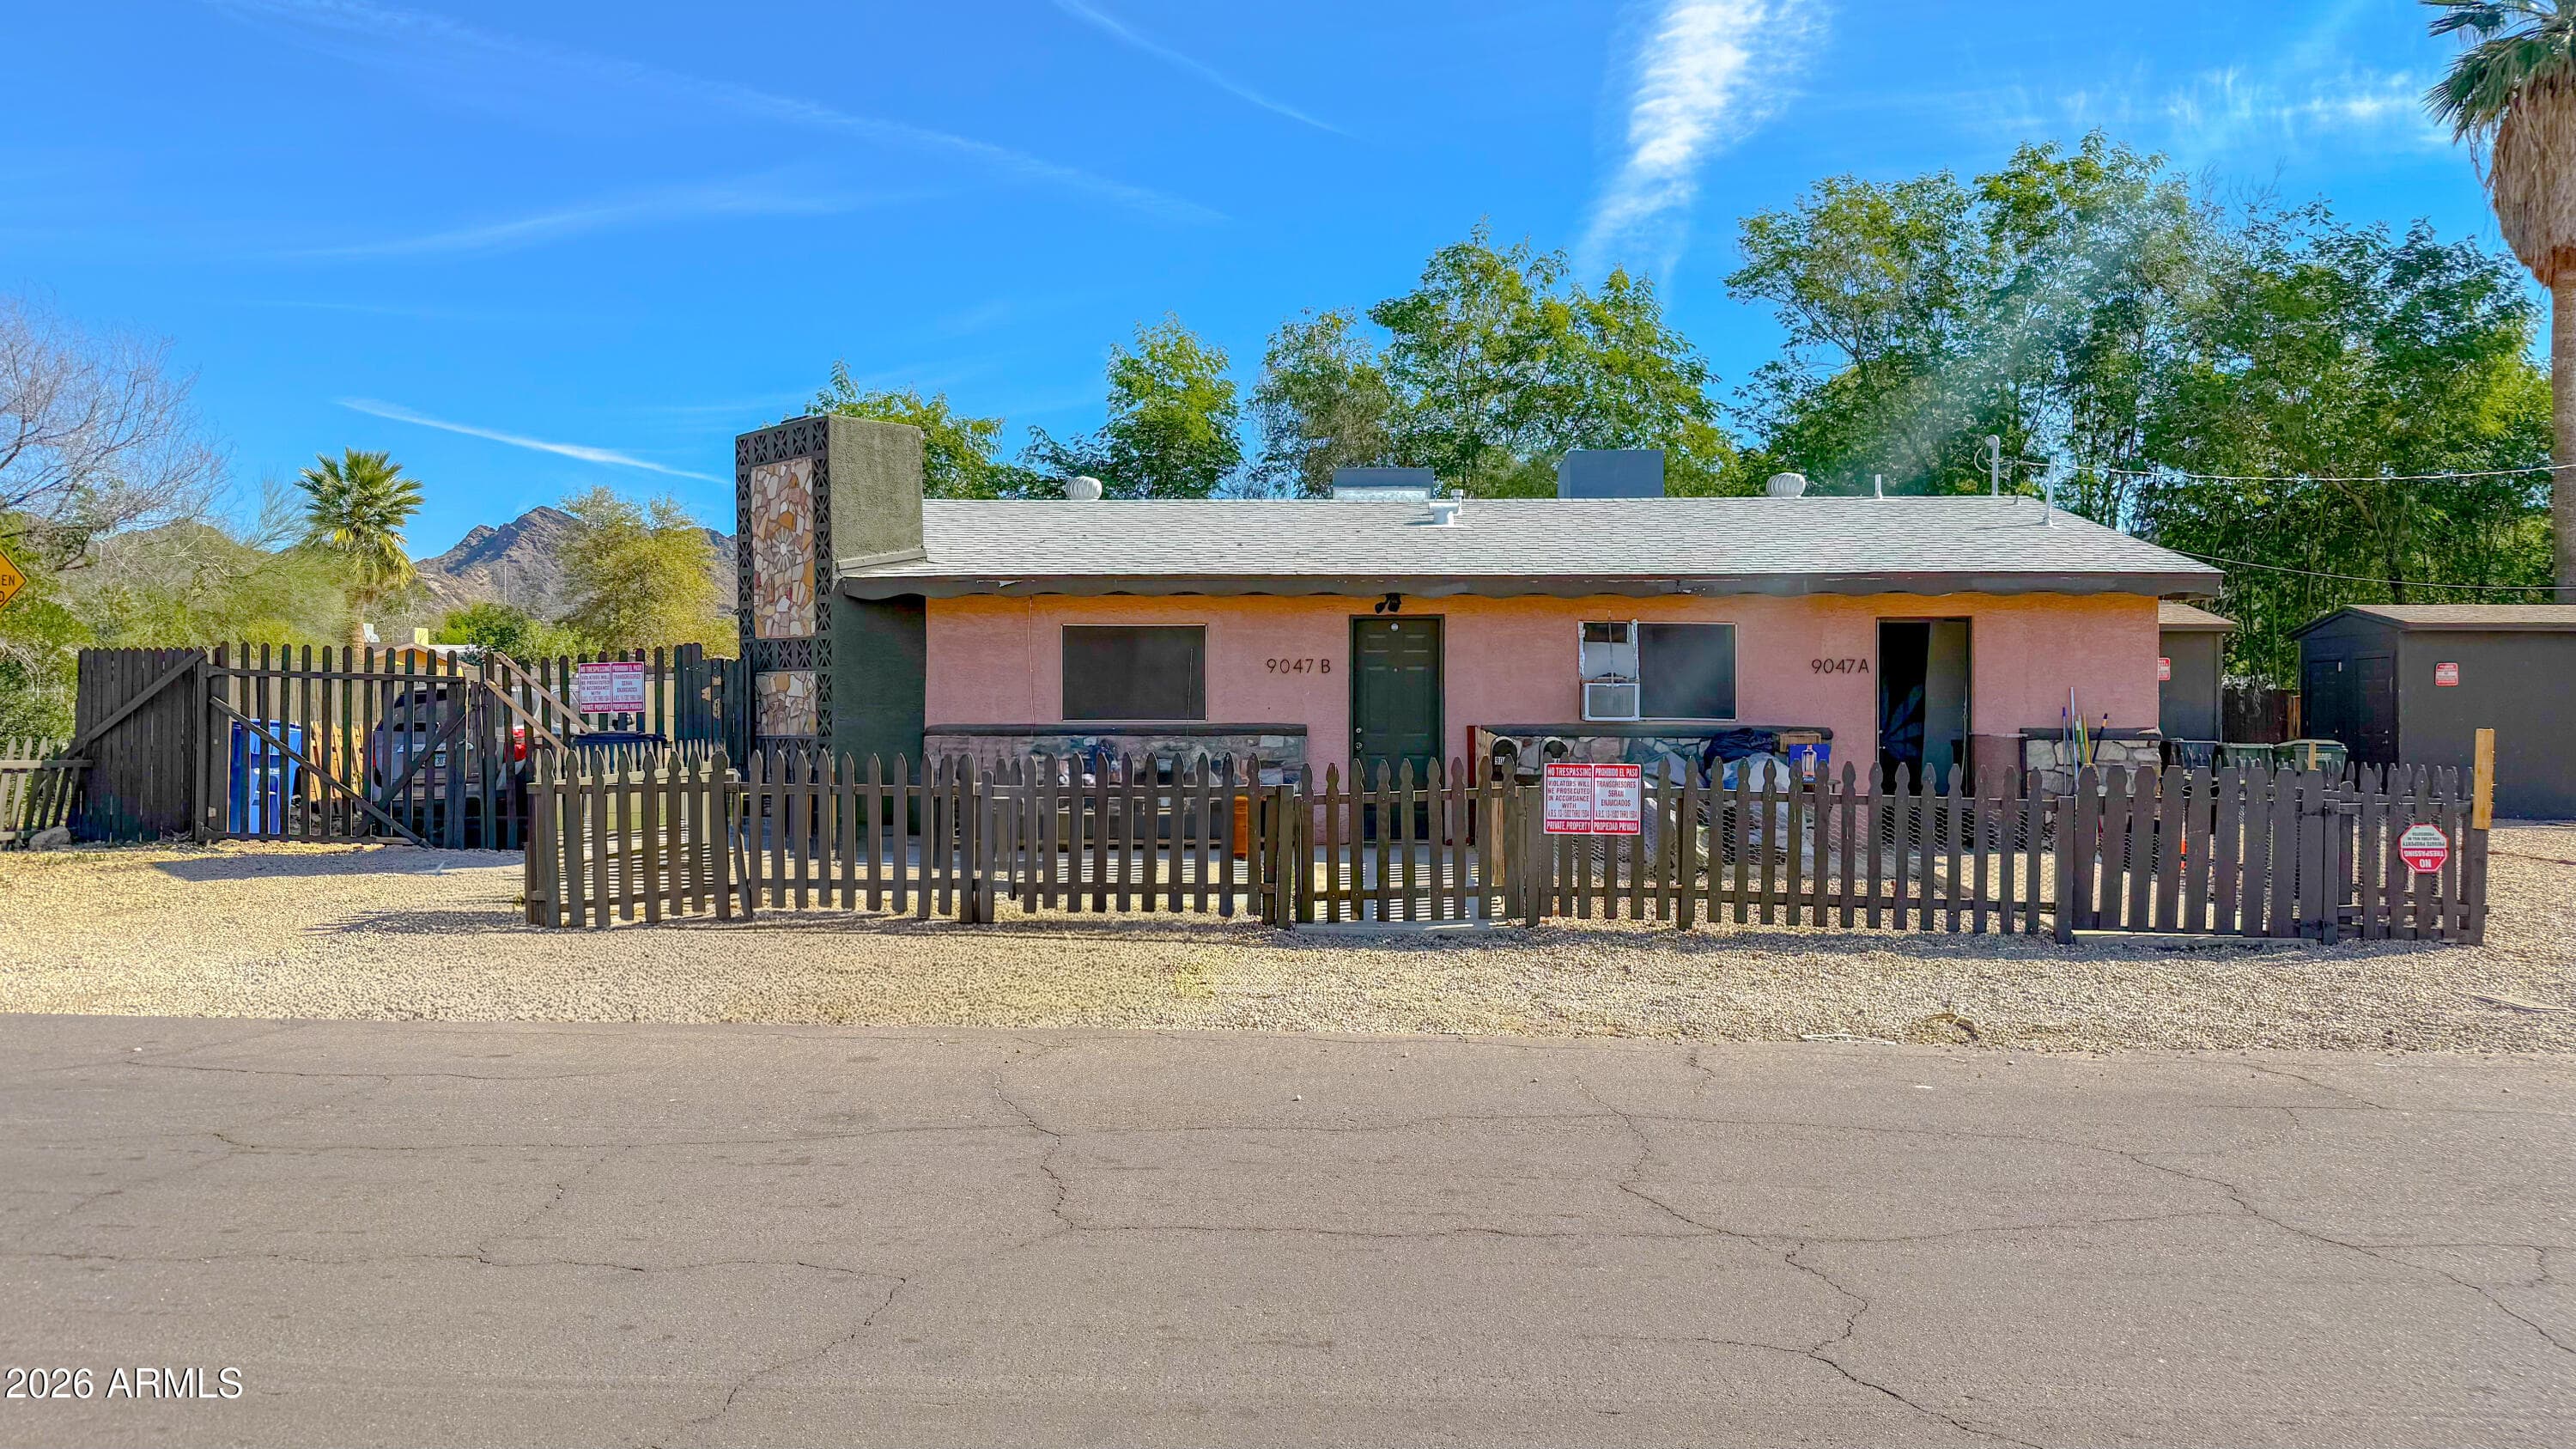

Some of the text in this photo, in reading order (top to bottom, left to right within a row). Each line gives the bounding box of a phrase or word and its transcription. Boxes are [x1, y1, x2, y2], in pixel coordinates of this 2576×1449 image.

[1267, 658, 1331, 673] 9047 B
[1547, 766, 1592, 777] NO TRESPASSING
[1619, 767, 1625, 777] EL
[1625, 767, 1638, 777] PASO
[1546, 820, 1590, 831] PRIVATE PROPERTY
[2420, 859, 2432, 868] NO
